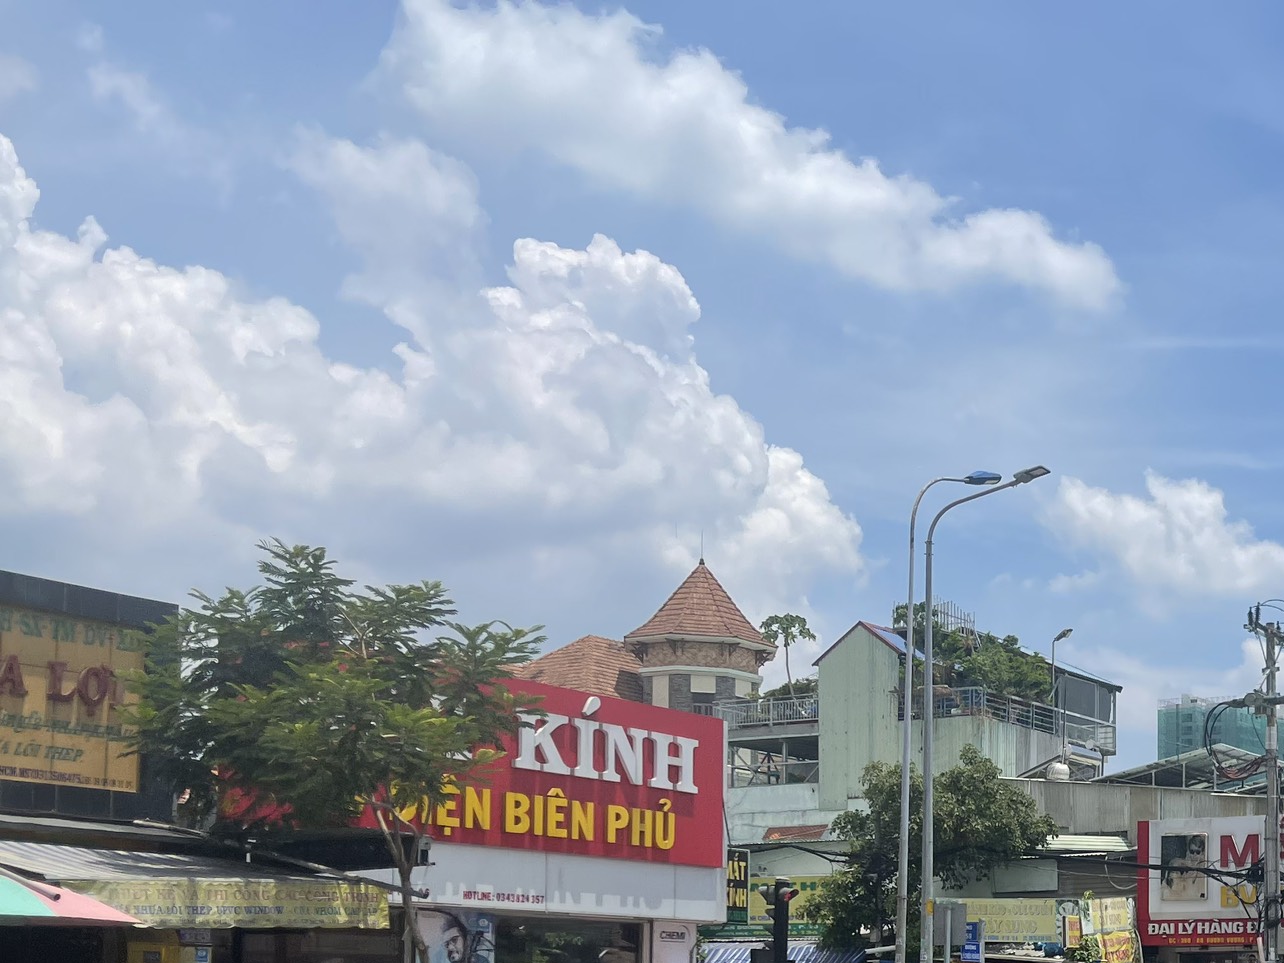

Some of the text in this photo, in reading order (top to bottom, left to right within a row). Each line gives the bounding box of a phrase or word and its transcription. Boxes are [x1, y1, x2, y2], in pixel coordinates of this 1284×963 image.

[512, 697, 699, 794] KÍNH
[505, 787, 595, 842] BIÊN
[607, 798, 676, 850] PHỦ
[243, 905, 284, 916] WINDOW
[1148, 923, 1175, 938] ĐẠI
[1178, 919, 1197, 934] LÝ
[1196, 918, 1244, 934] HÀNG
